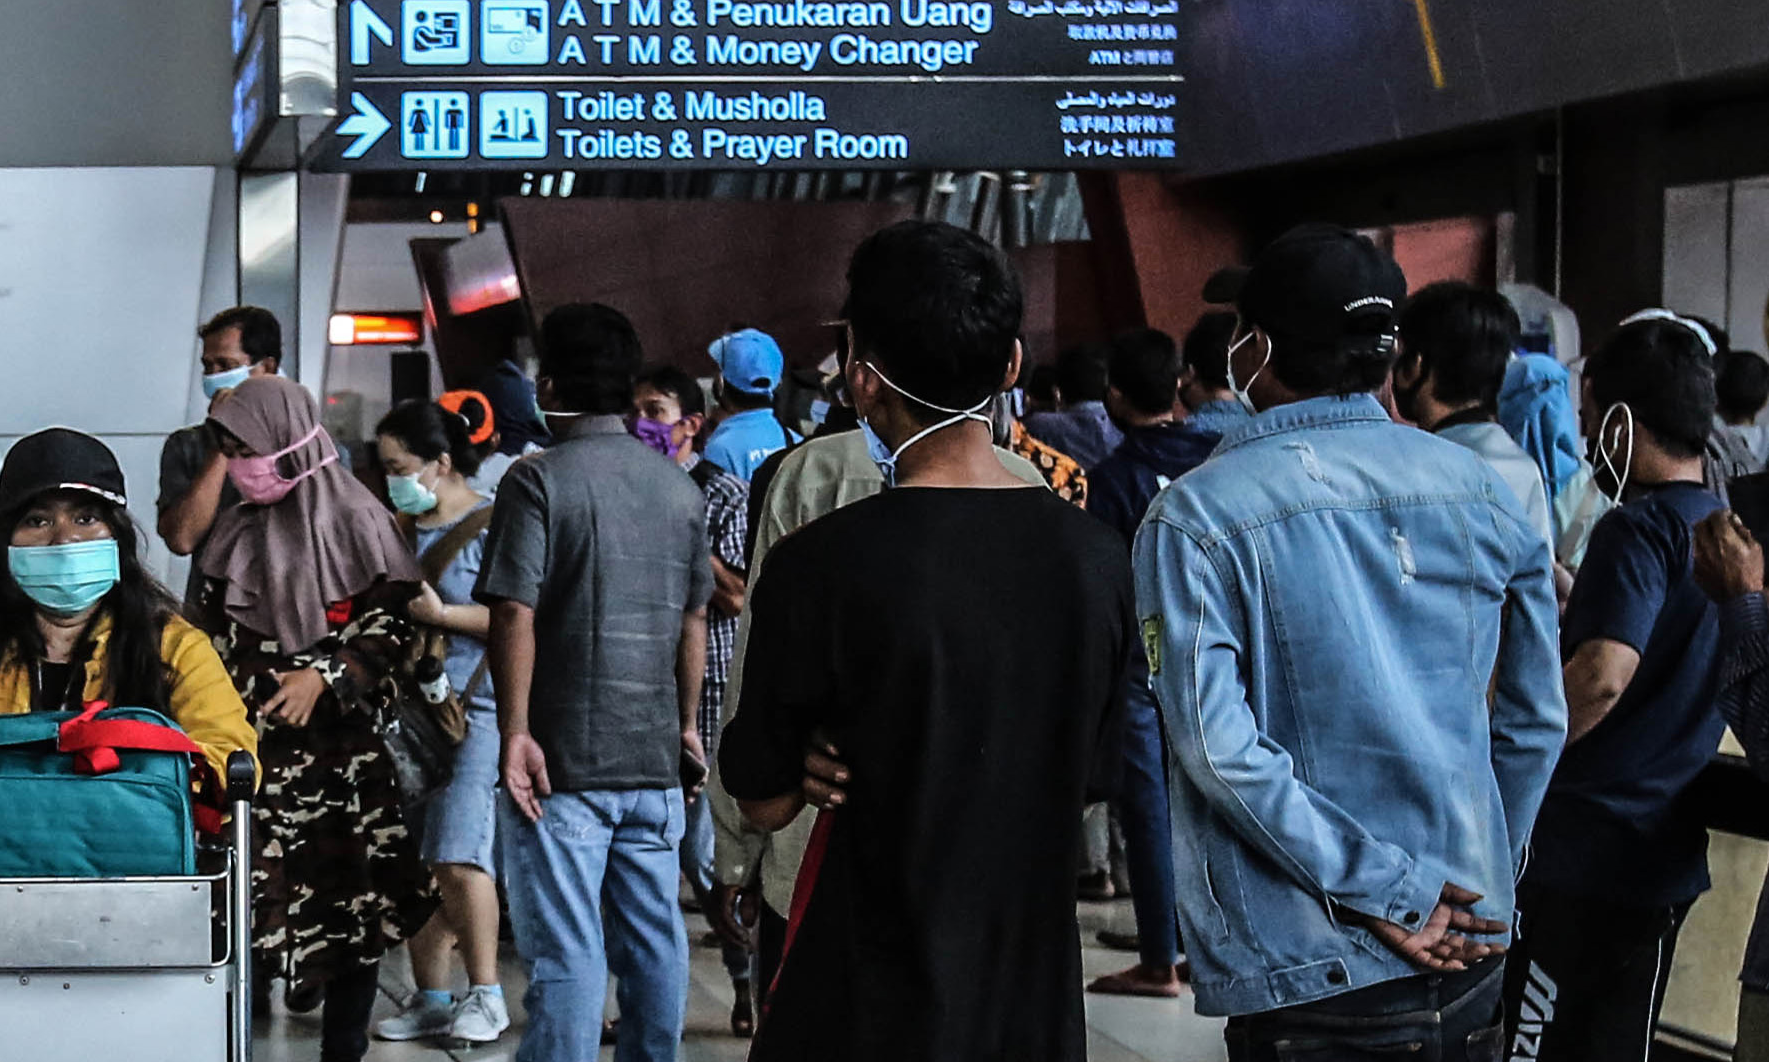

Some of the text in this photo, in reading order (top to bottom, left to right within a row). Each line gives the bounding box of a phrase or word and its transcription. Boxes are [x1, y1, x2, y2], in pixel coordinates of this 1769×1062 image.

[669, 0, 698, 26] &
[706, 0, 892, 26] Penukaran
[900, 0, 993, 33] Uang
[669, 35, 698, 65] &
[706, 35, 822, 71] Money
[830, 34, 979, 71] Changer
[556, 91, 826, 121] Toilet & Musholla
[556, 128, 908, 165] Toilets & Prayer Room
